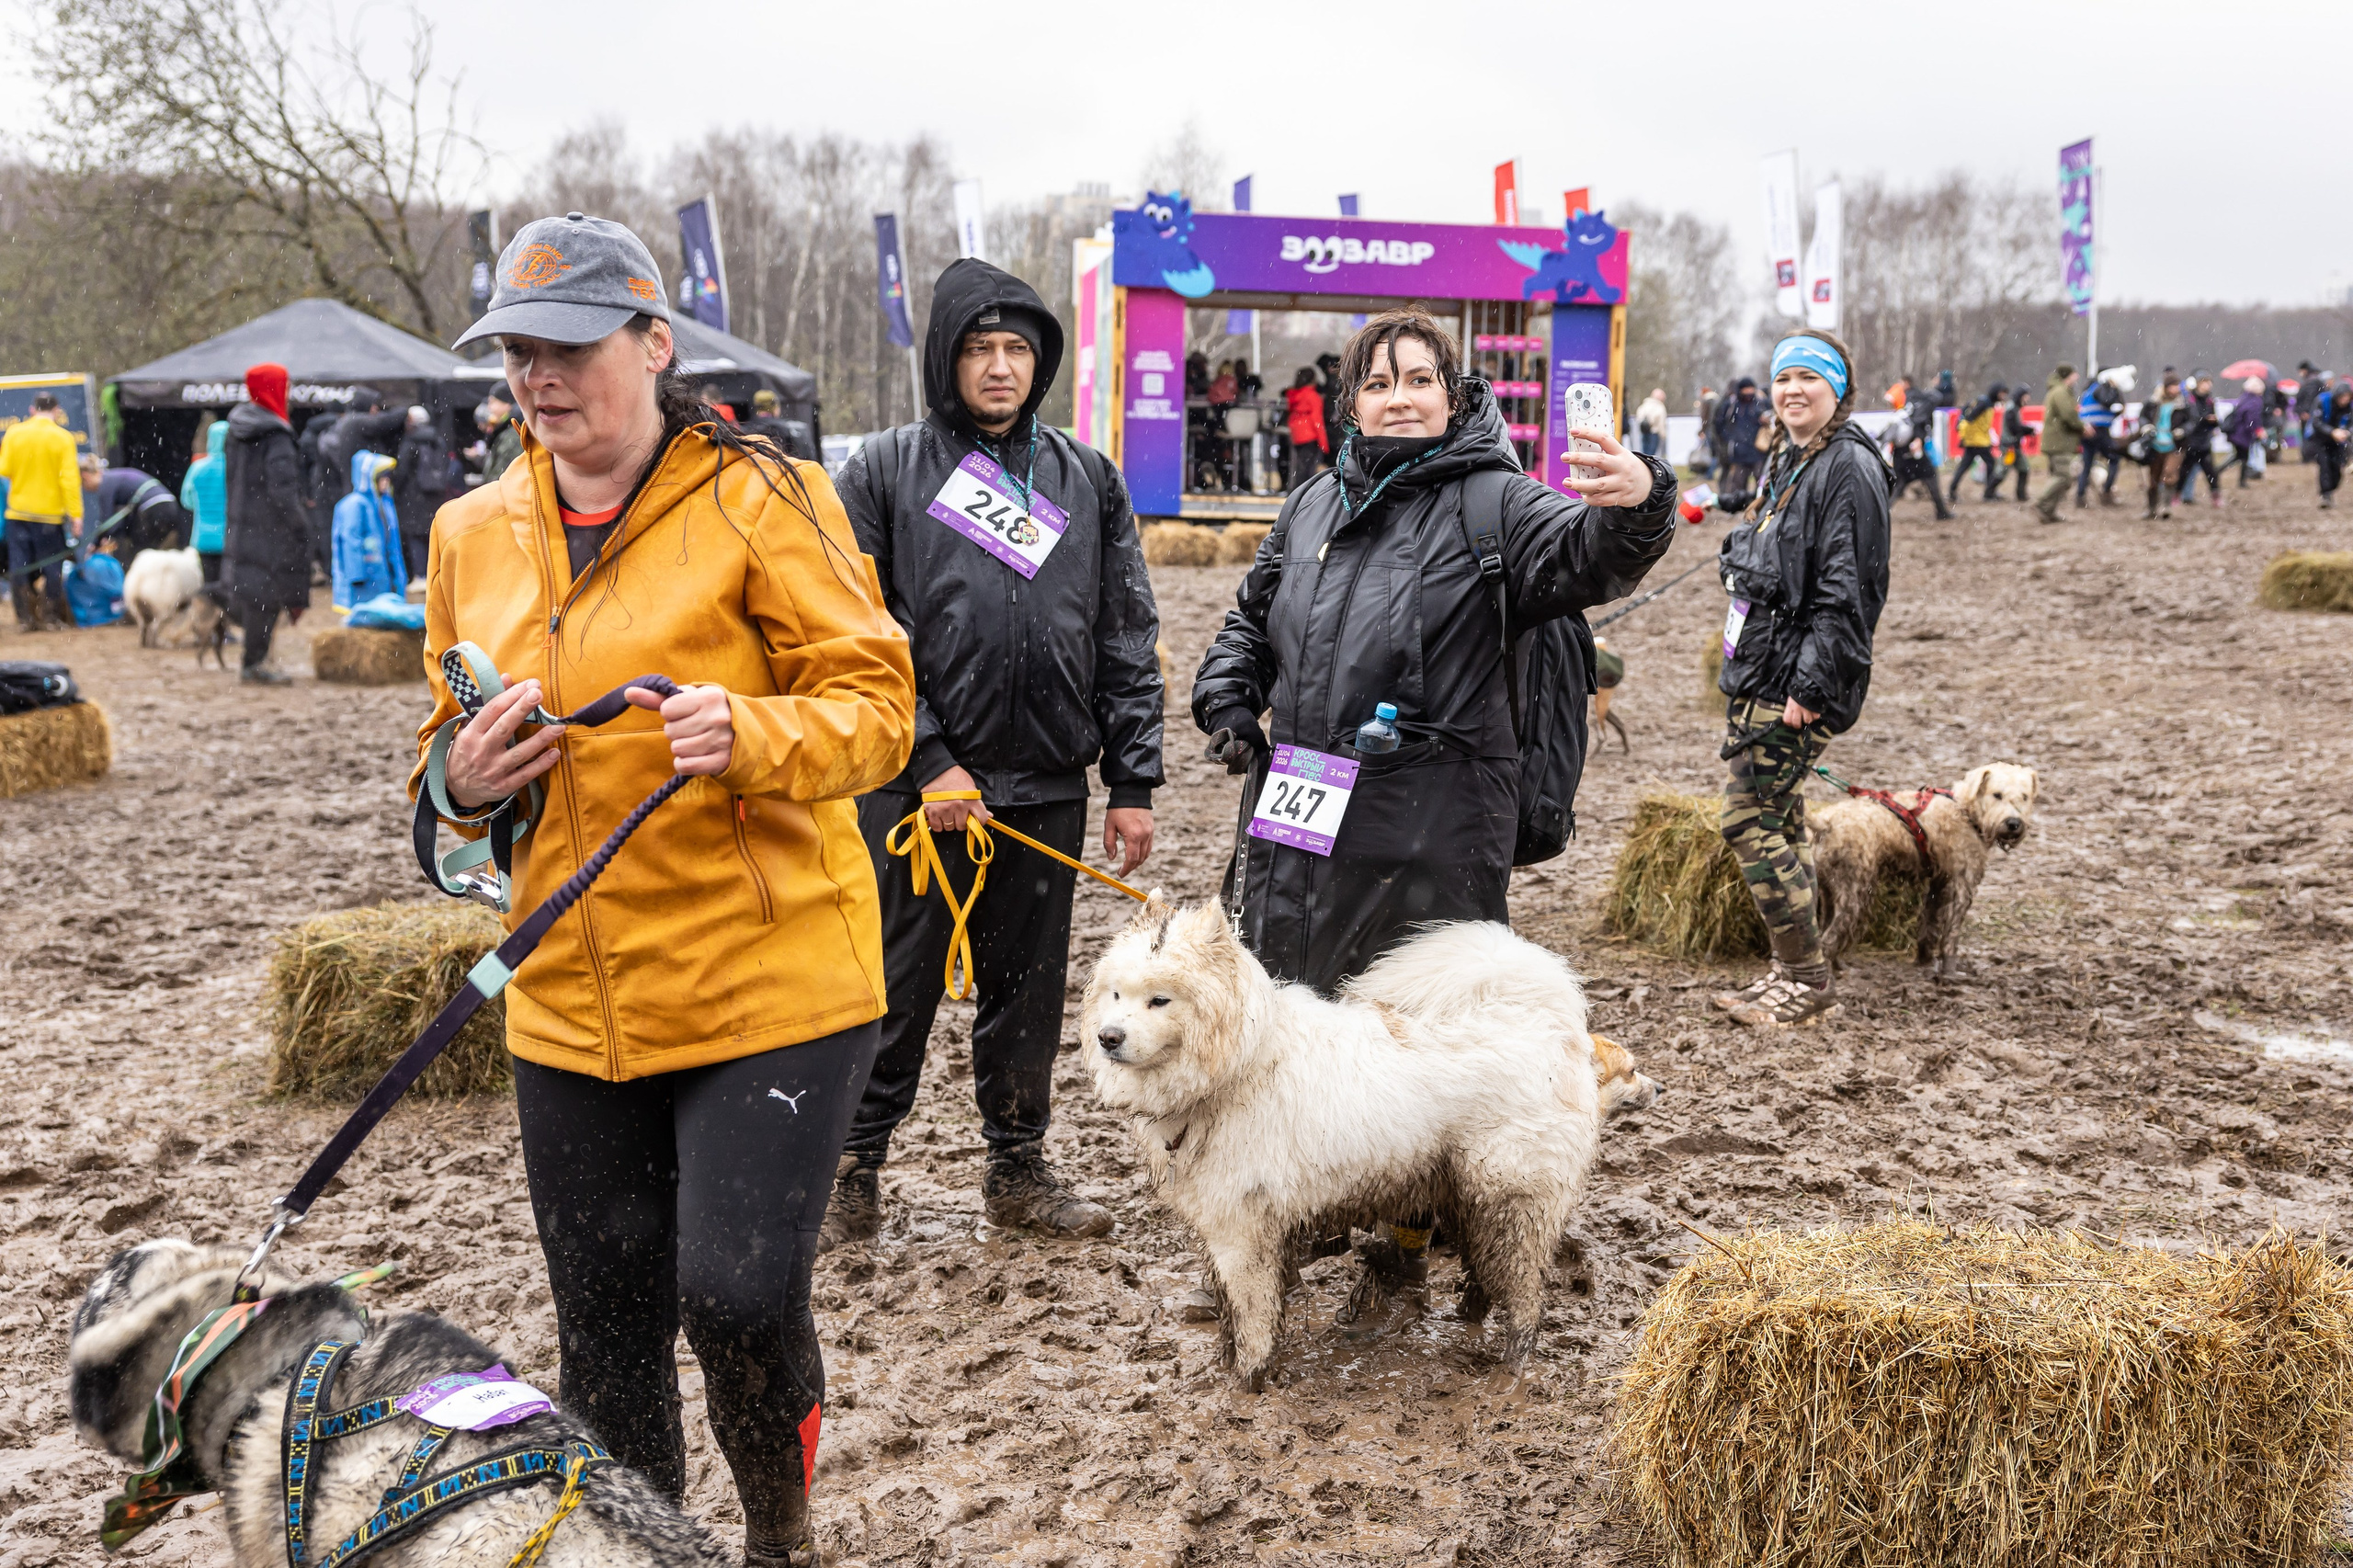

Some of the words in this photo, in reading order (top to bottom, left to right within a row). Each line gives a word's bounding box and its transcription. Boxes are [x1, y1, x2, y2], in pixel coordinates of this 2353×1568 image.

[1279, 235, 1435, 274] ЗООЗАВР
[968, 460, 992, 479] 2026
[964, 490, 1029, 545] 248
[1275, 756, 1288, 766] 2026
[1293, 748, 1320, 763] КРОСС
[1330, 767, 1336, 776] 2
[1269, 780, 1327, 824] 247
